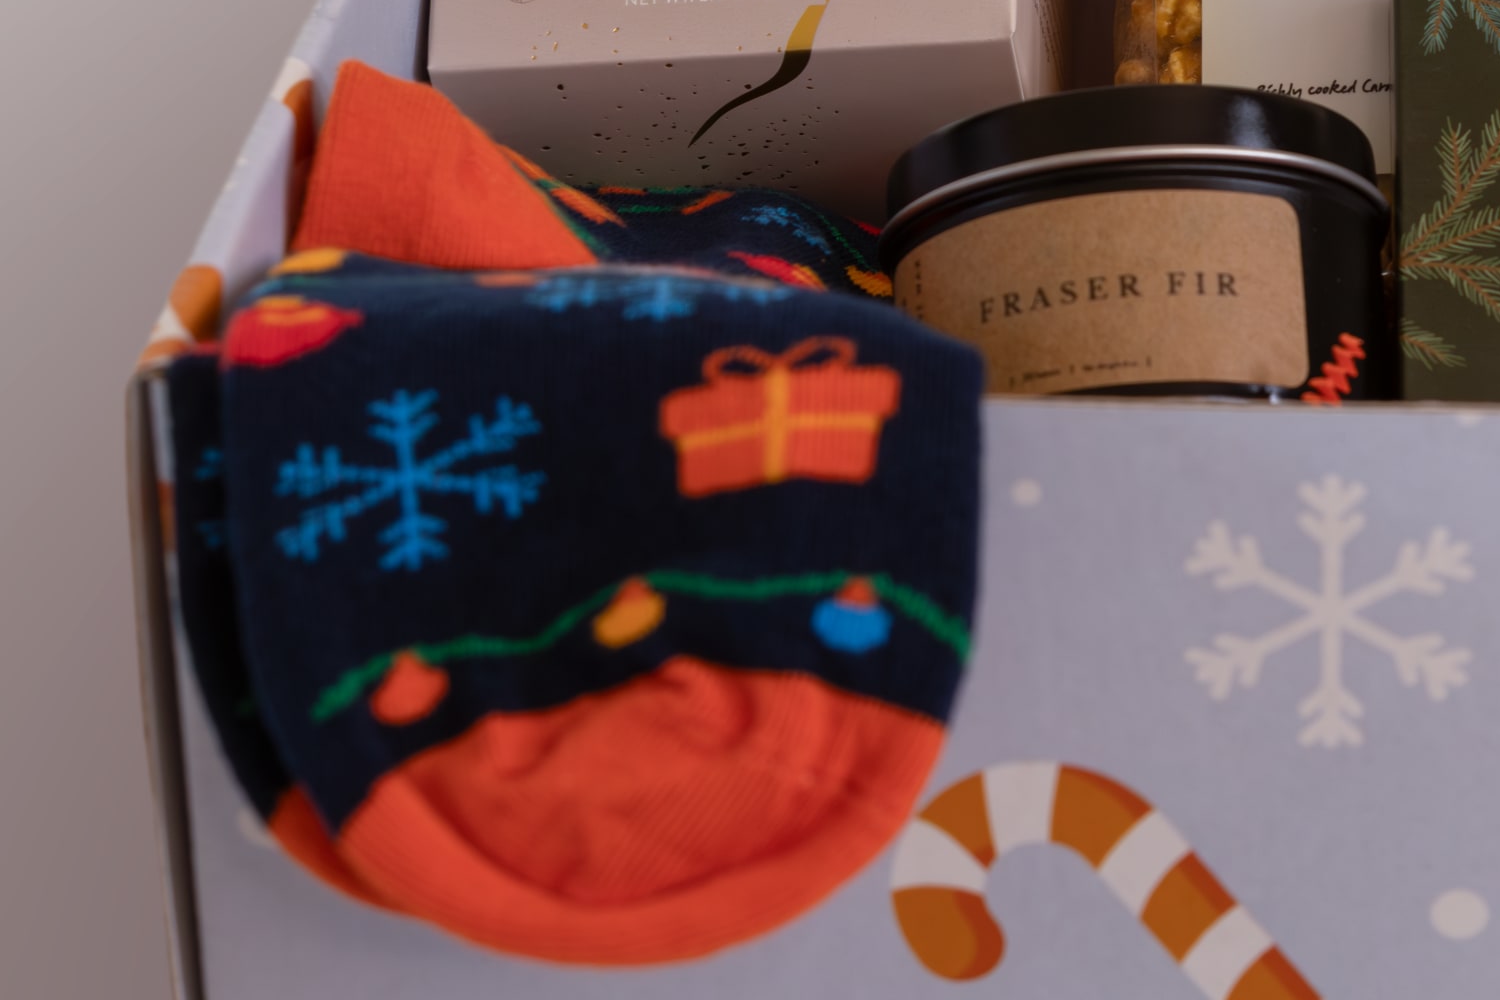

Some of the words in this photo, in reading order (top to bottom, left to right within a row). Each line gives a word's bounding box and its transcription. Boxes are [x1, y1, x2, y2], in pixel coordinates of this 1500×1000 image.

[1307, 79, 1358, 96] cooked
[979, 272, 1141, 325] FRASER
[1166, 271, 1239, 297] FIR
